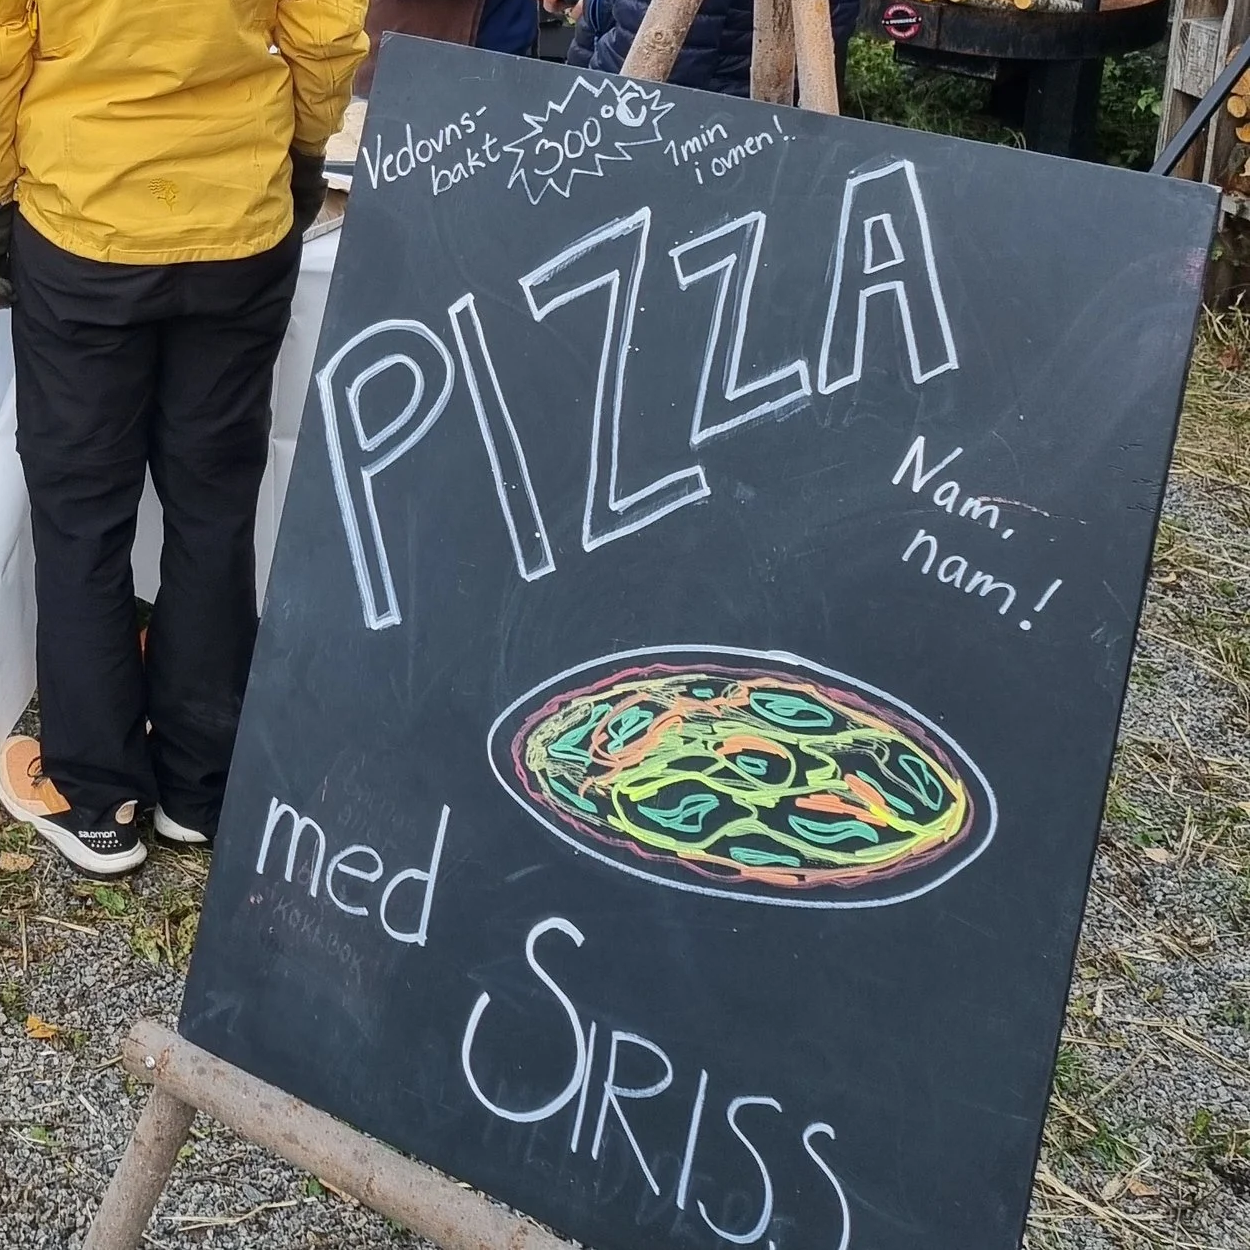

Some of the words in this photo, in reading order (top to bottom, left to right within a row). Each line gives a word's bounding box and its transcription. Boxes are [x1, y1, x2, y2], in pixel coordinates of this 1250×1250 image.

[362, 106, 488, 189] Vedovns-
[430, 134, 503, 196] bakt
[317, 161, 959, 630] PIZZA
[891, 435, 1015, 540] Nam,
[901, 529, 1063, 631] nam!
[255, 796, 451, 947] med
